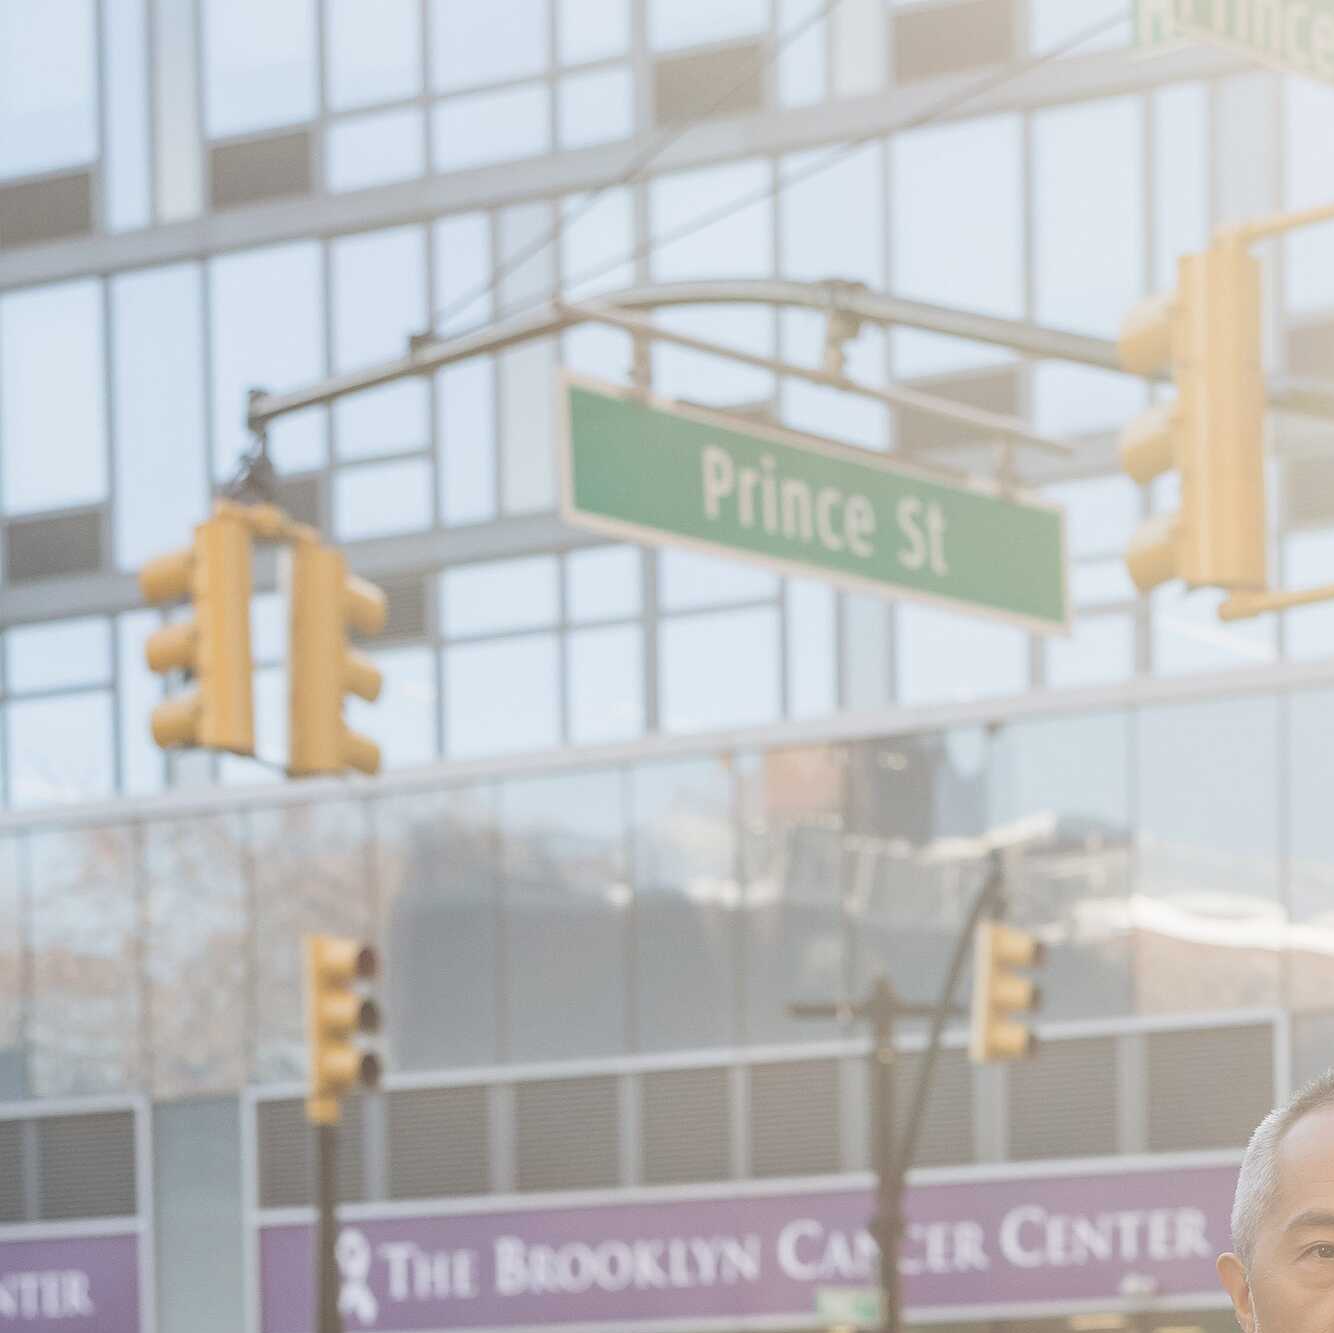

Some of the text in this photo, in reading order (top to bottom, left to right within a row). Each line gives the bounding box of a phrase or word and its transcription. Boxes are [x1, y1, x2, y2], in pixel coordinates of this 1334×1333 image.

[702, 443, 949, 577] Prince St
[379, 1240, 477, 1301] THE
[495, 1233, 762, 1297] BROOKLYN
[1000, 1204, 1212, 1268] CENTER
